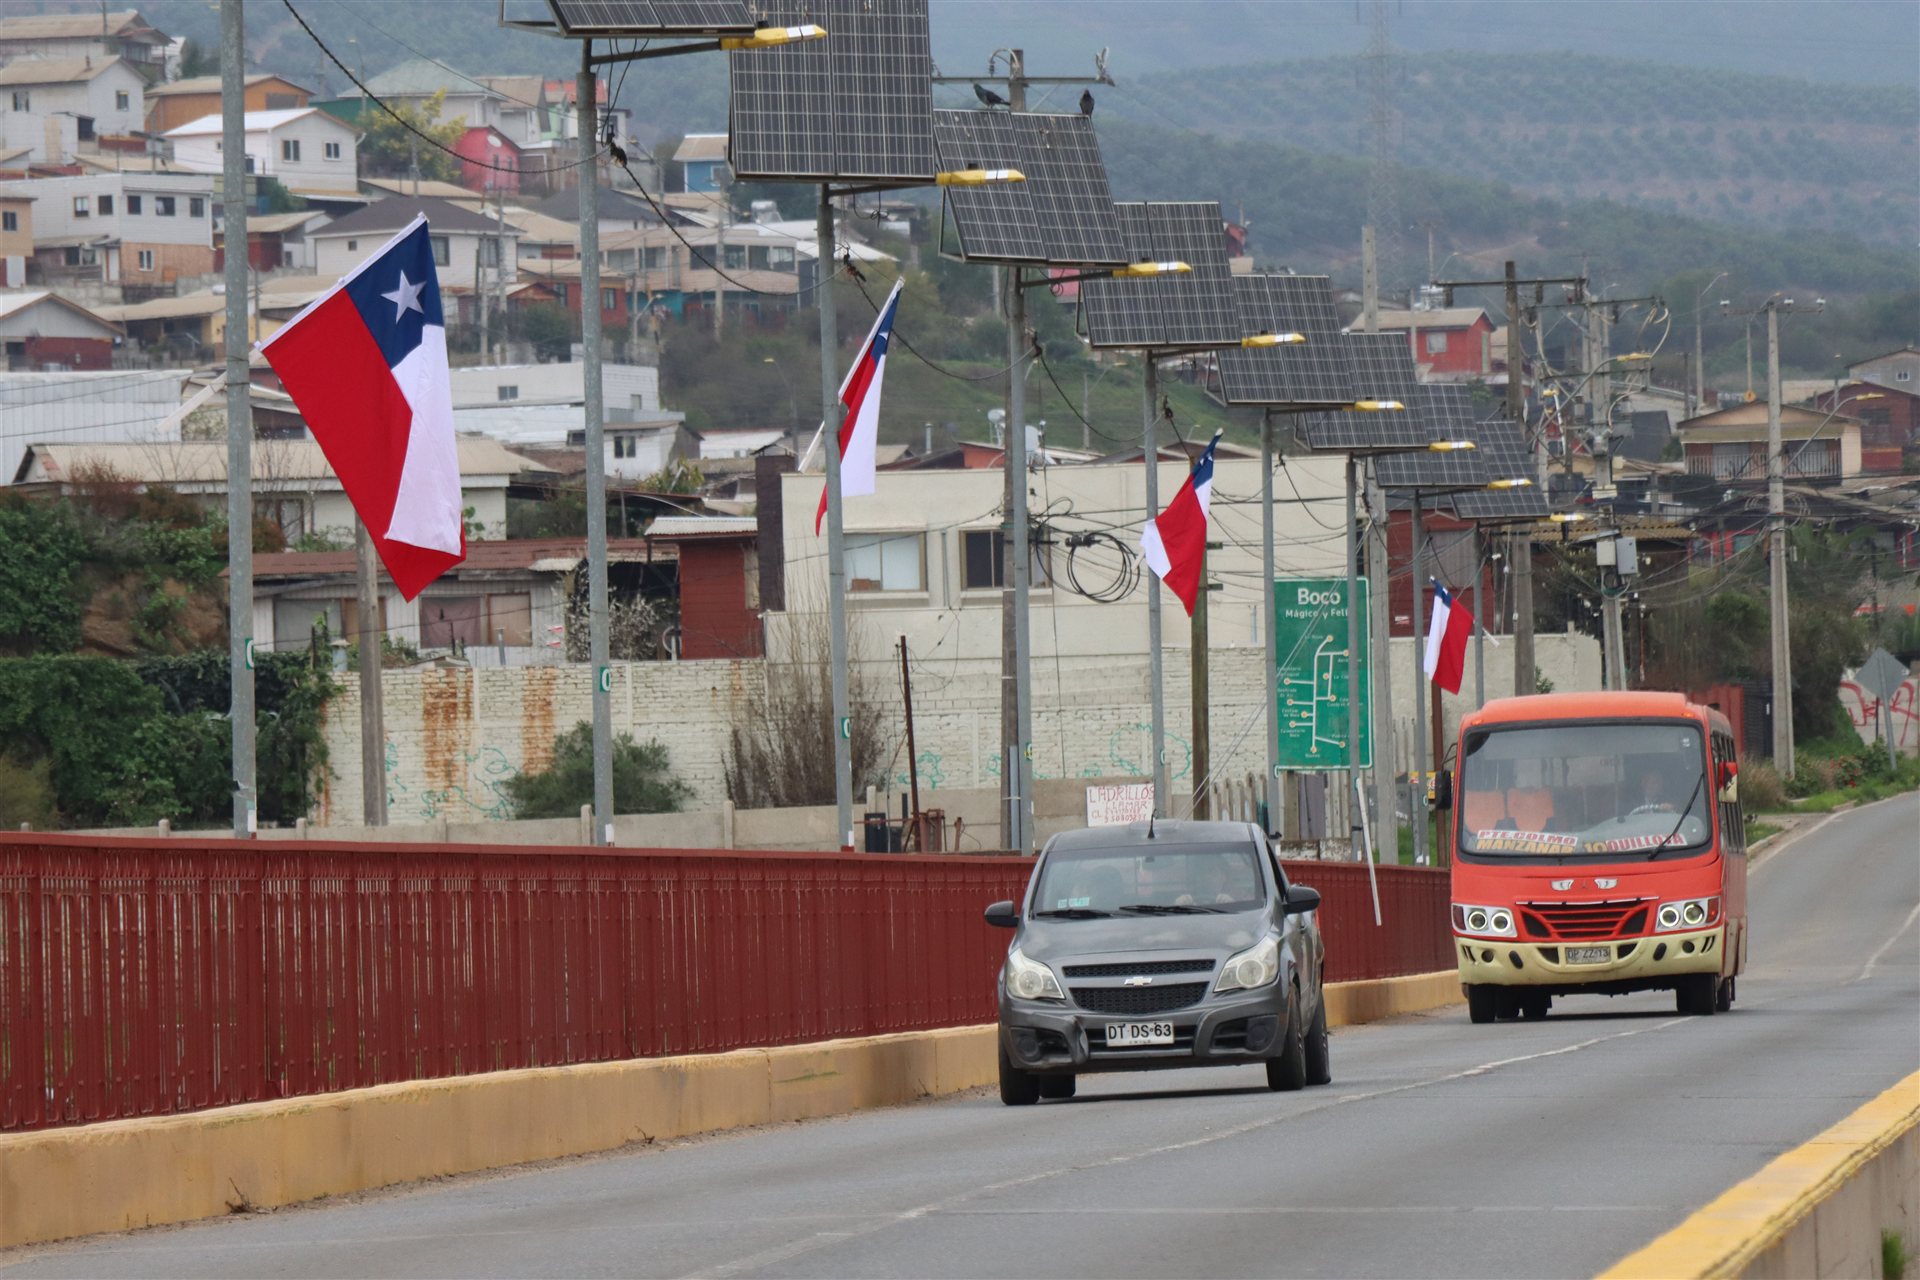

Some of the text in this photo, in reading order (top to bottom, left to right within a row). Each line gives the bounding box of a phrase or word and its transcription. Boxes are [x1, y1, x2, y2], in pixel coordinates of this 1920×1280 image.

[1297, 587, 1341, 605] Boco
[1285, 608, 1349, 620] Mágico y Feli
[1089, 785, 1154, 803] LADRILLOS
